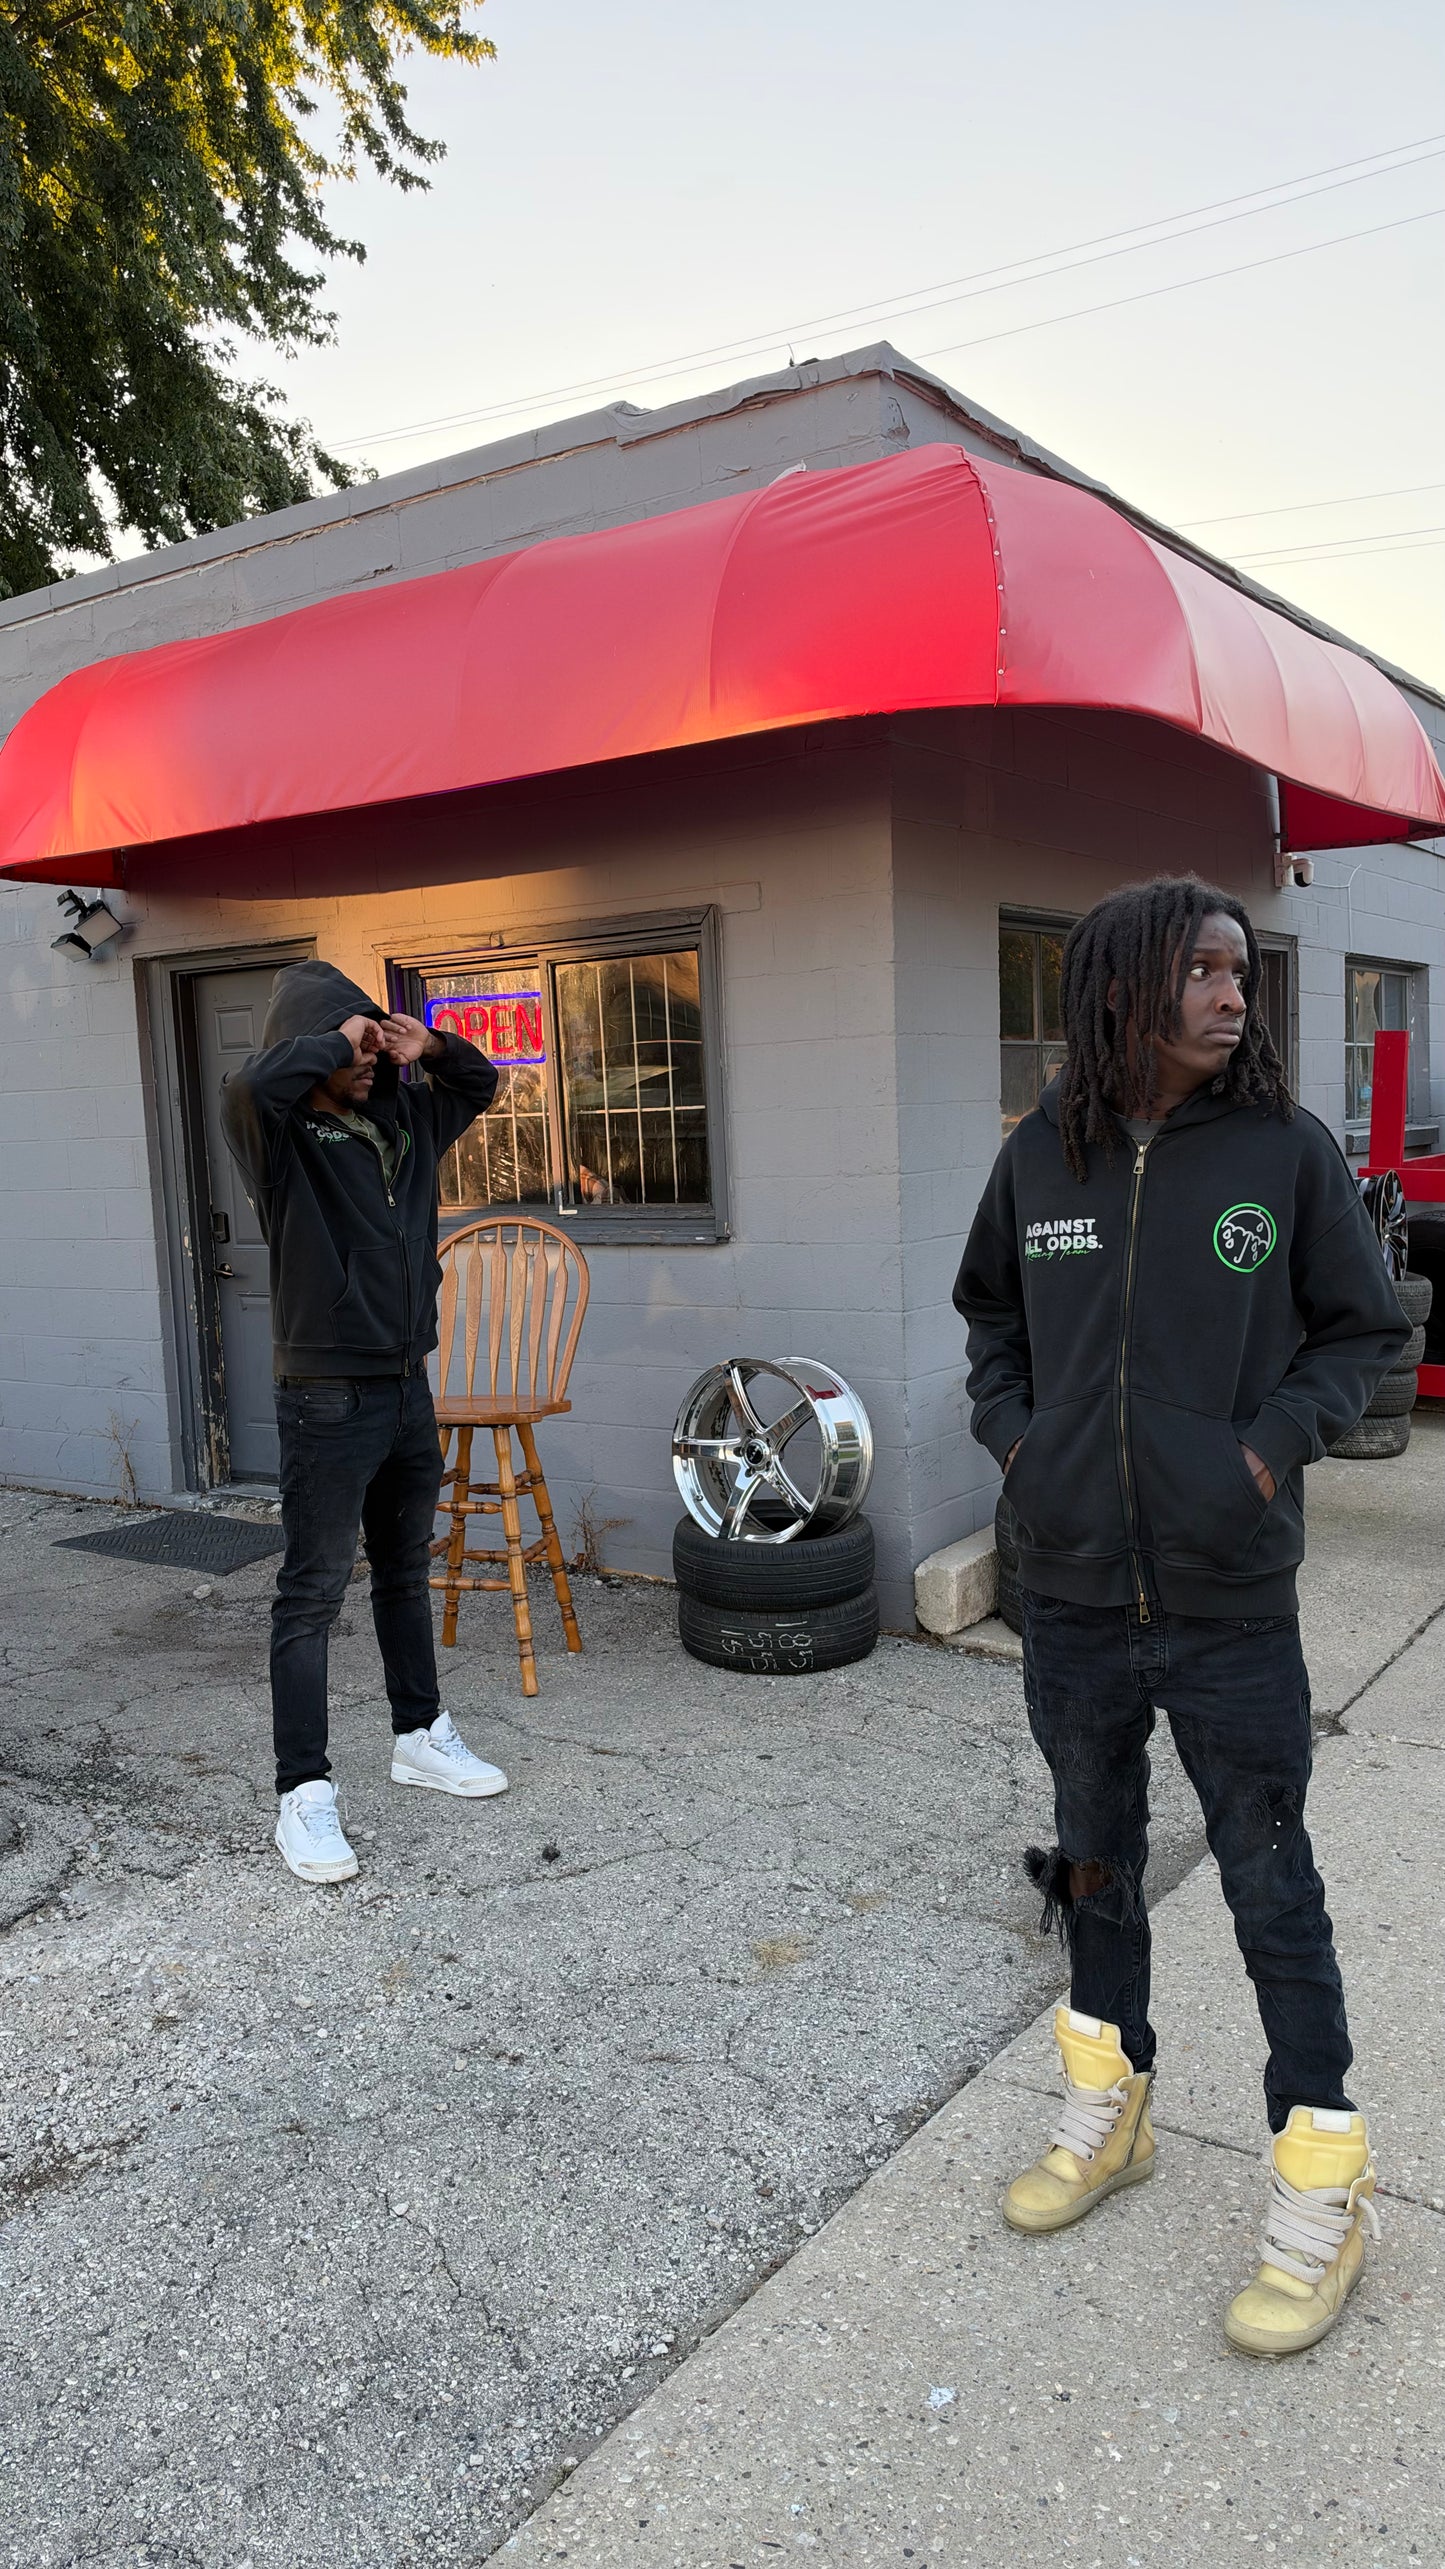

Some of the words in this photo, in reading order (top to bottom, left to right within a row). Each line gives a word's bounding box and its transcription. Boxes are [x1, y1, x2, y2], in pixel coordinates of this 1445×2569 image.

[435, 1003, 544, 1054] OPEN
[1026, 1218, 1096, 1239] AGAINST
[1025, 1239, 1043, 1256] ALL
[1047, 1235, 1103, 1251] ODDS.
